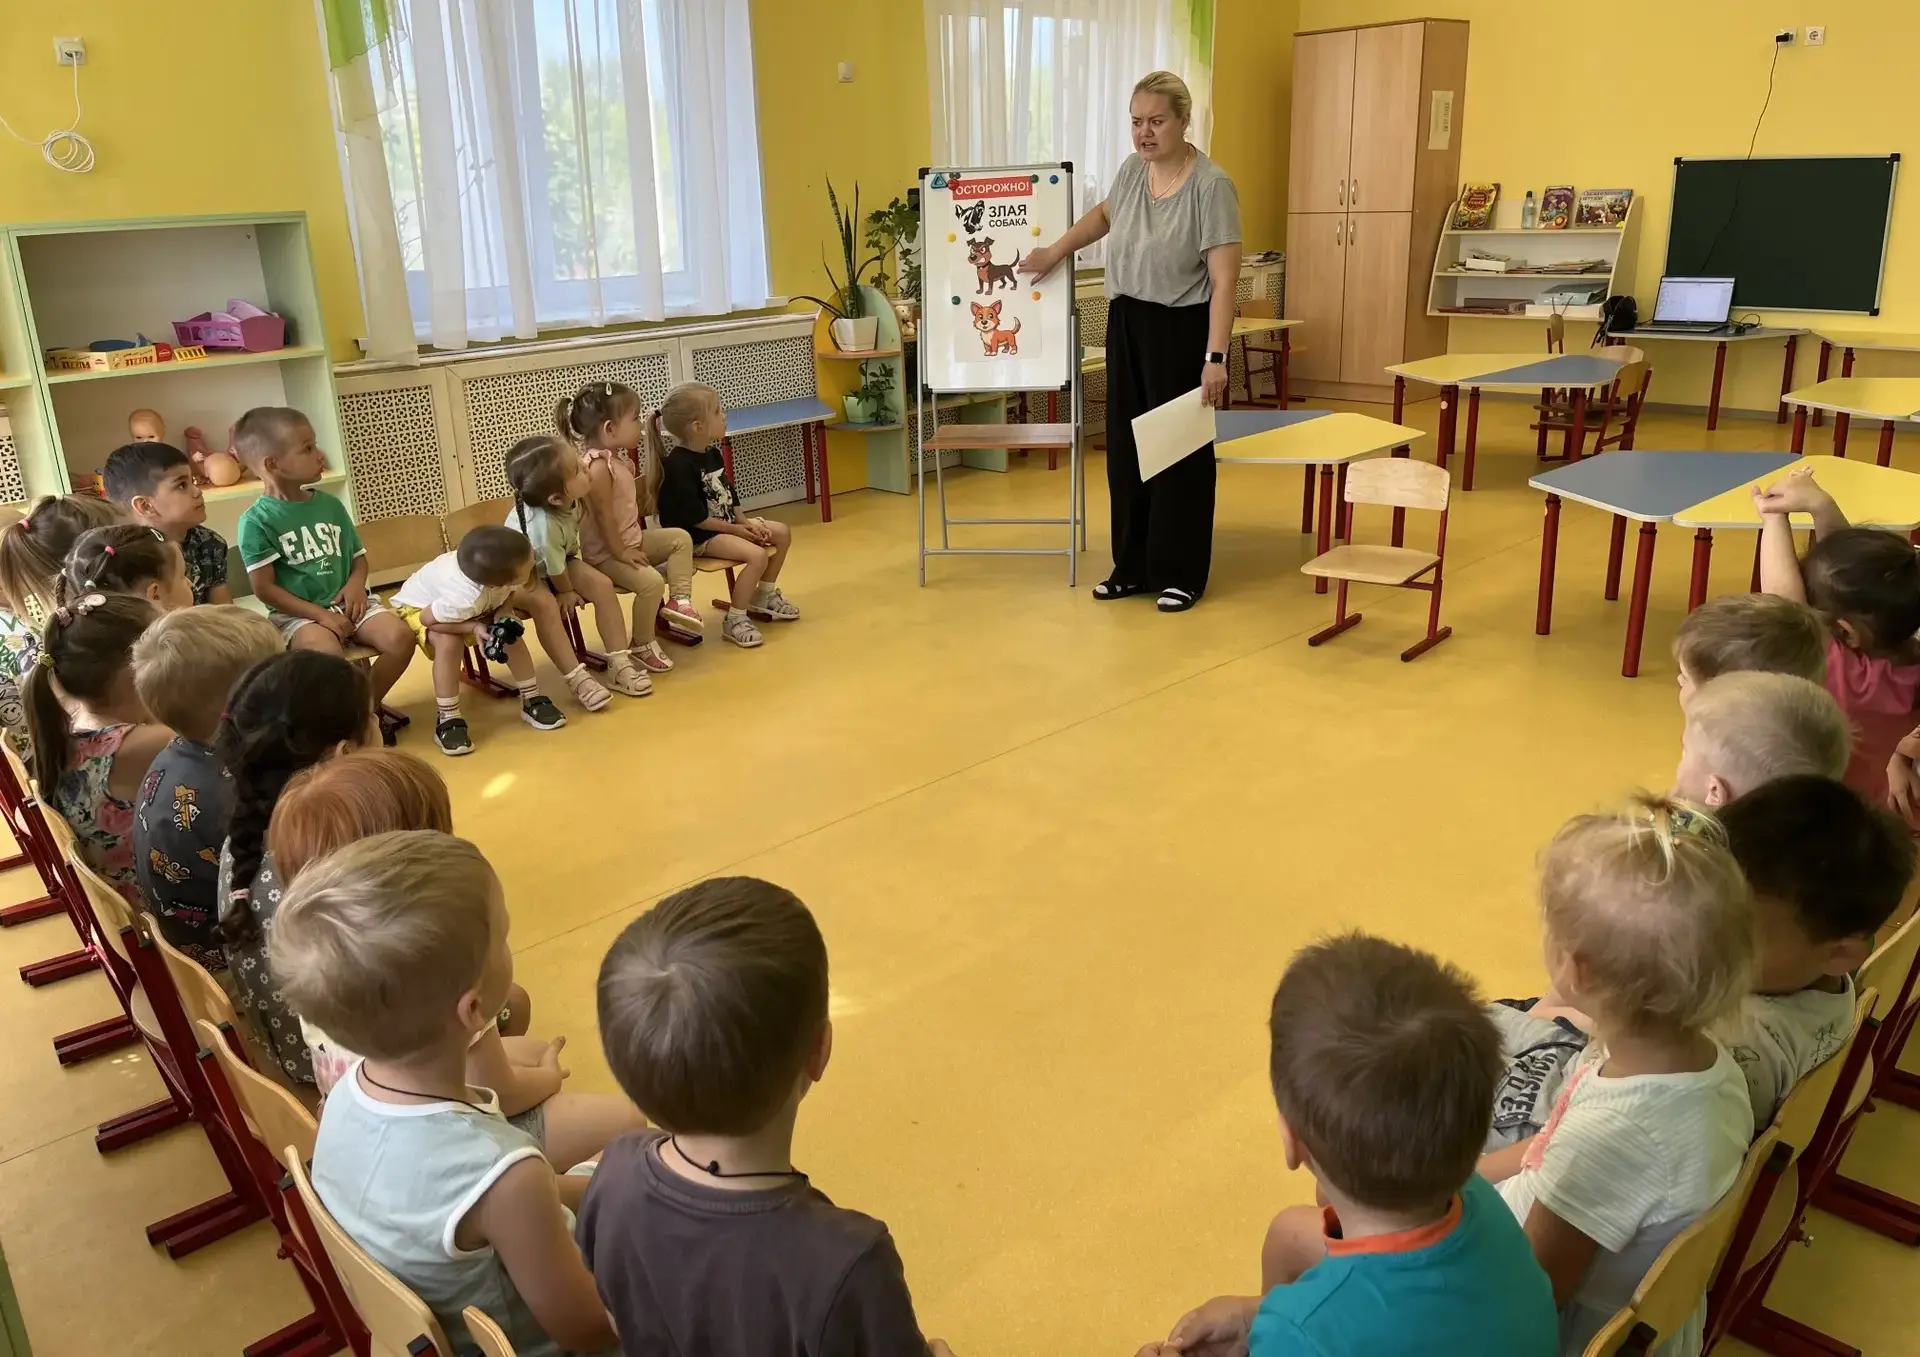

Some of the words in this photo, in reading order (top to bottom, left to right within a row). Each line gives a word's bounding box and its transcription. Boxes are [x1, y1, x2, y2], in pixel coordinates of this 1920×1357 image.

[956, 182, 1029, 195] ОСТОРОЖНО!
[988, 204, 1027, 218] ЗЛАЯ
[988, 218, 1028, 228] СОБАКА
[125, 356, 153, 367] PUZZLE
[278, 522, 342, 565] EASY
